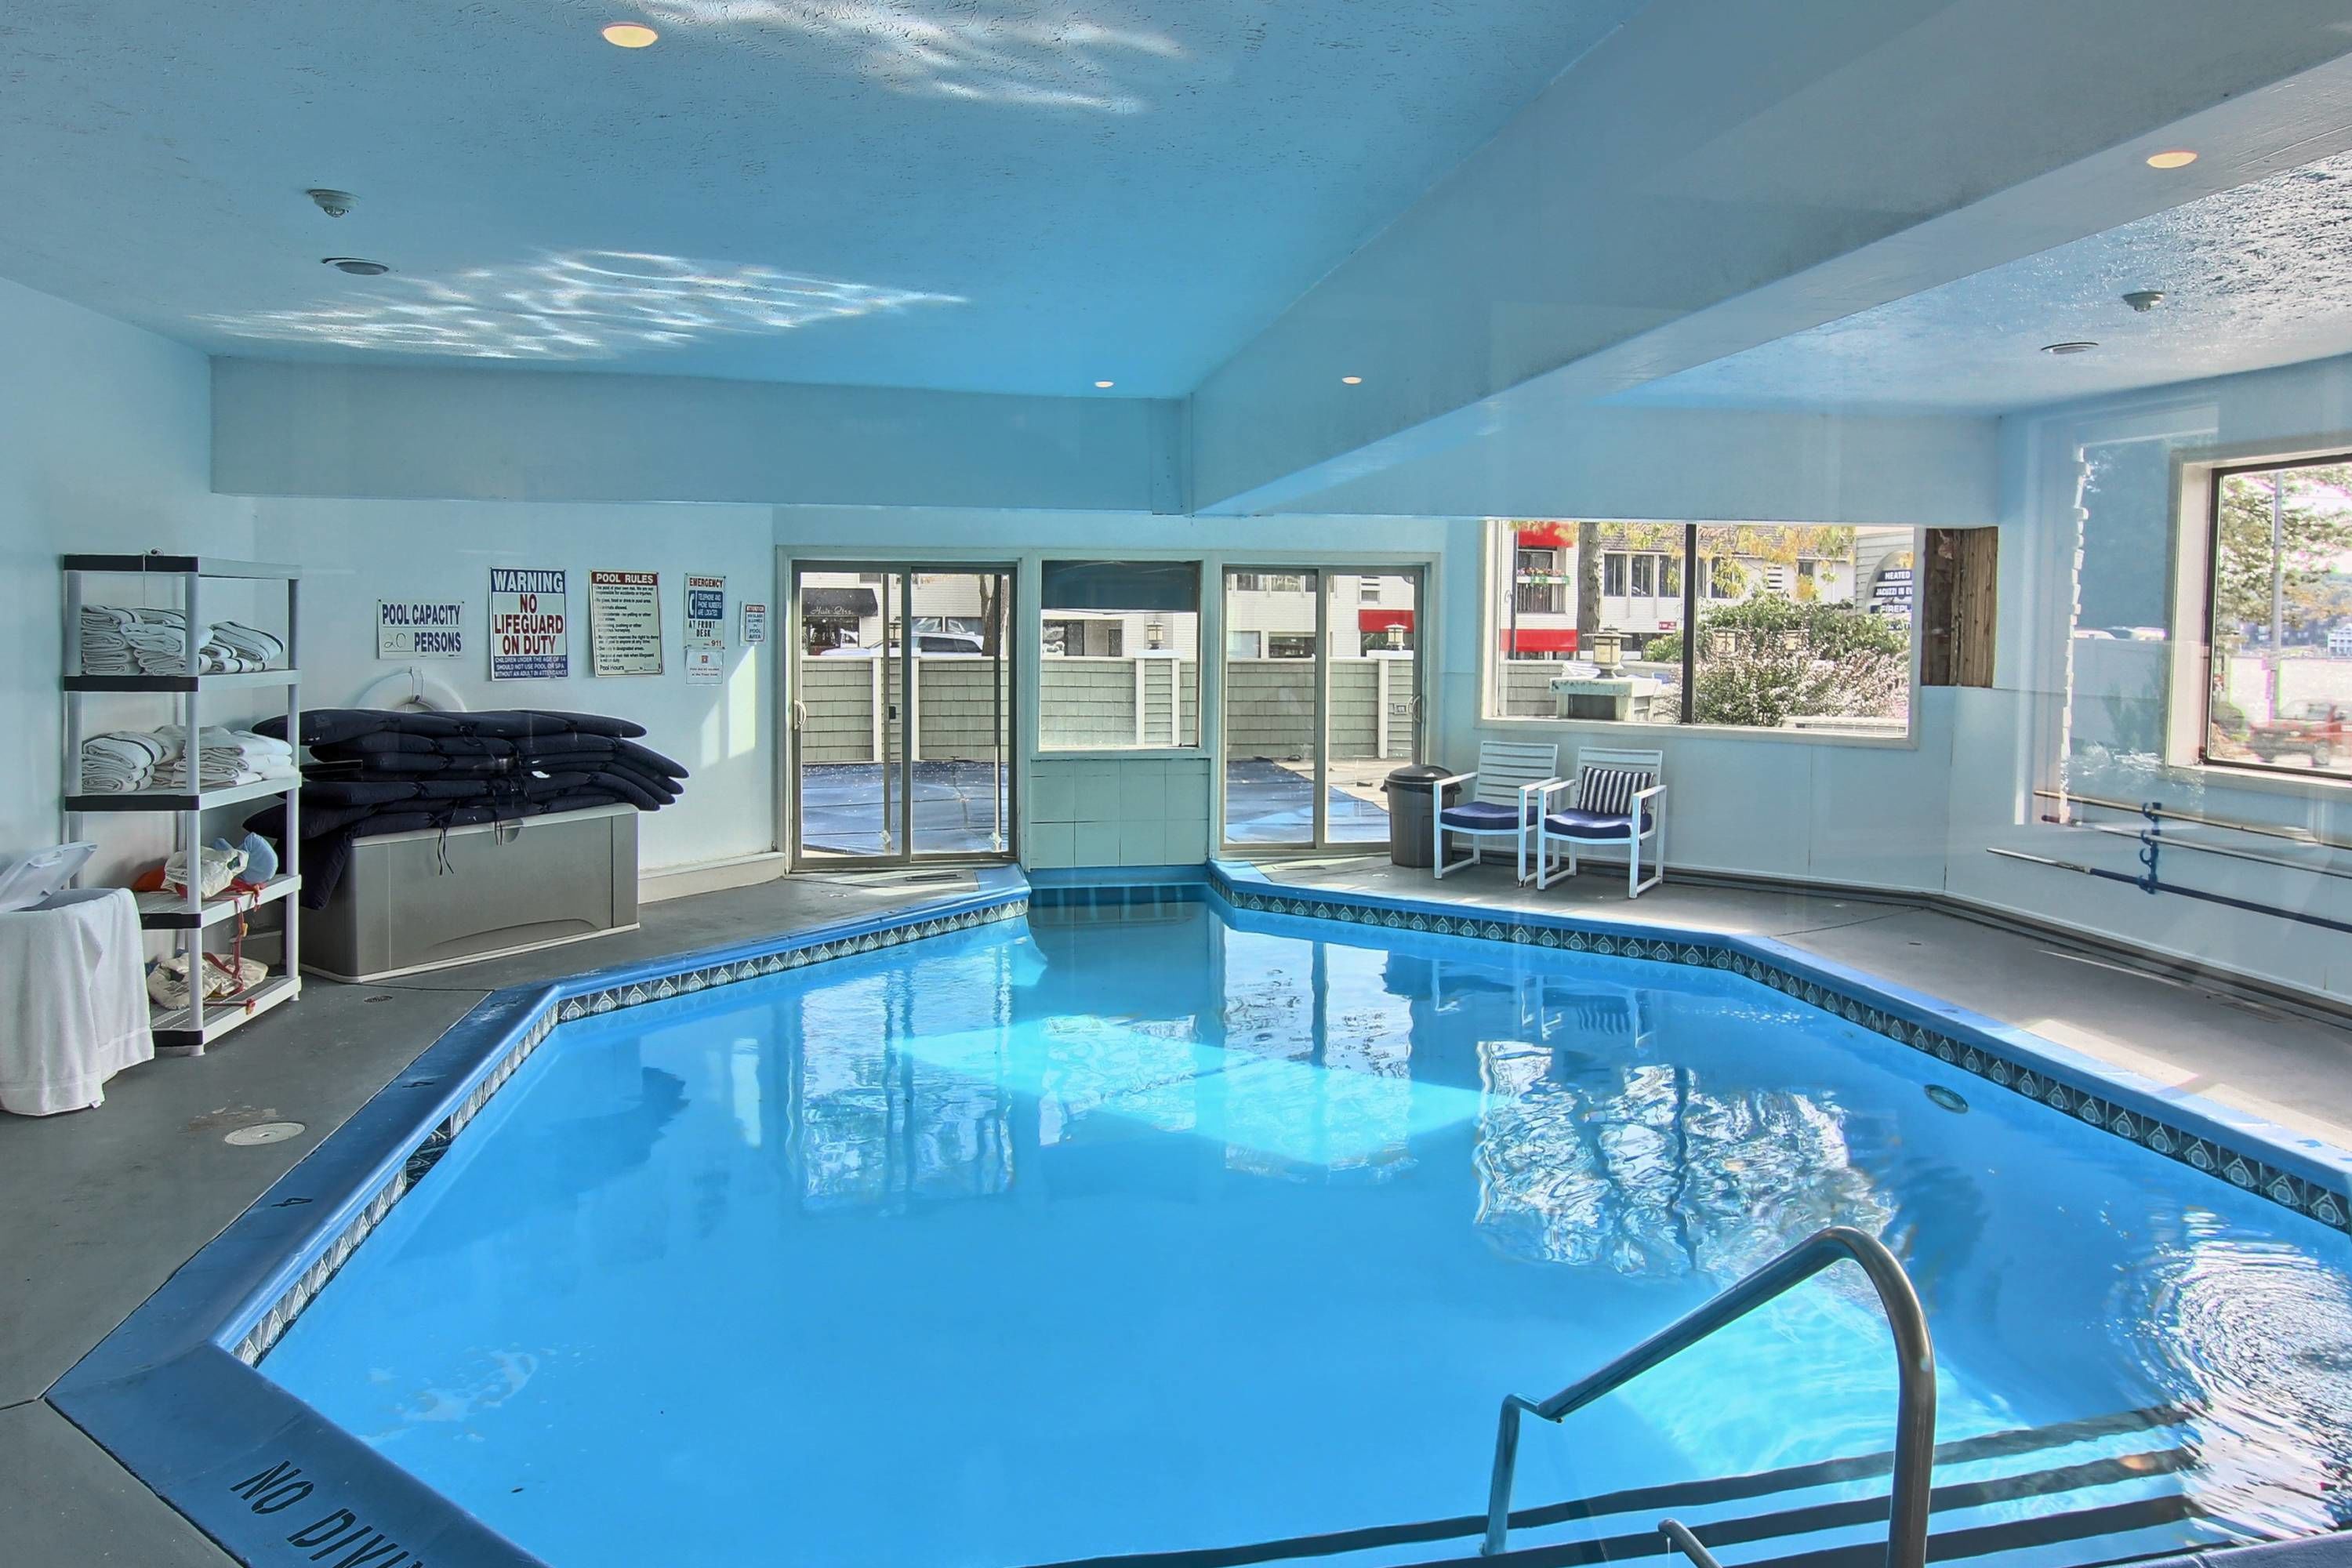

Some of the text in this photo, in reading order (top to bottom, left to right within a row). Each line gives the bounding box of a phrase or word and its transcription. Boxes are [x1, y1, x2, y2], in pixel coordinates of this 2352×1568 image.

[493, 571, 564, 593] WARNING
[596, 573, 654, 584] POOL RULES
[689, 577, 724, 588] EMERGENCY
[1885, 571, 1911, 580] HEATED
[519, 593, 537, 614] NO
[382, 604, 461, 625] POOL CAPACITY
[494, 614, 564, 634] LIFEGUARD
[698, 620, 715, 629] FRONT
[414, 631, 462, 652] PERSONS
[696, 629, 711, 637] DESK
[503, 634, 556, 655] ON DUTY
[230, 1460, 424, 1568] NO DIVI
